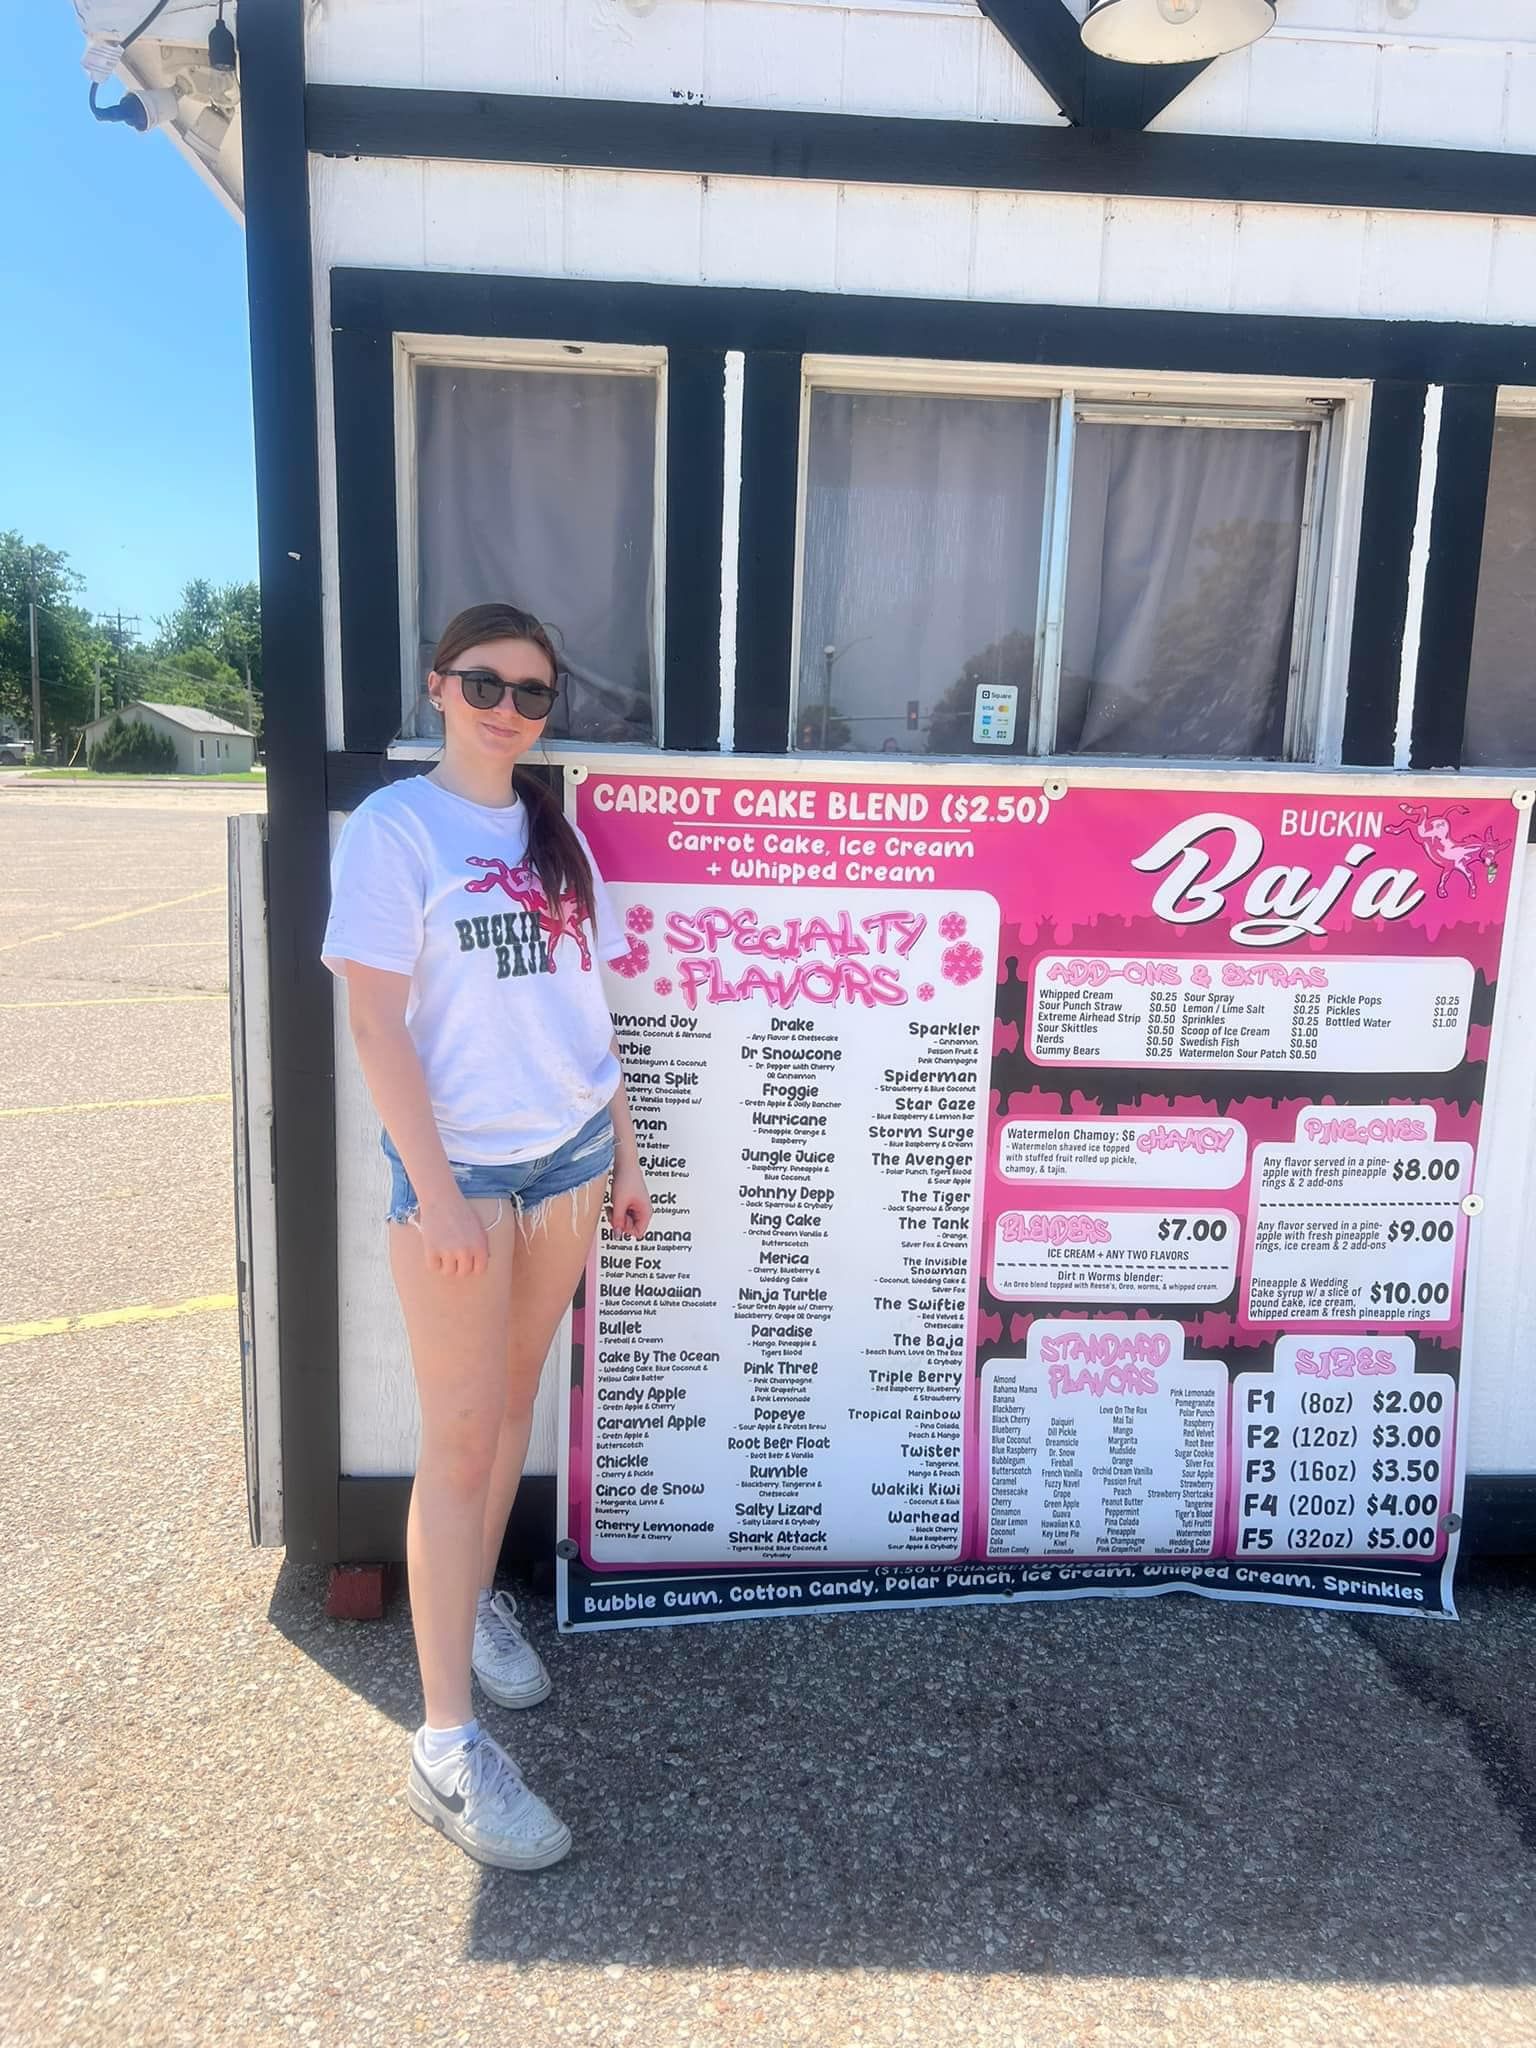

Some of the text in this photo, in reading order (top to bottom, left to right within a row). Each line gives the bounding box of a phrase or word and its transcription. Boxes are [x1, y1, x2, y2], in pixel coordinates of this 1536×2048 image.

[593, 783, 1049, 824] CARROT CAKE BLEND ($2.50)
[1280, 810, 1384, 839] BUCKIN
[667, 830, 974, 858] Carrot Cake, Ice Cream
[706, 858, 935, 882] + Whipped Cream
[1131, 812, 1425, 946] Baja
[455, 911, 542, 952] BUCKIN
[496, 941, 550, 979] BAJA
[1040, 990, 1177, 1001] Whipped Cream $0.25
[1184, 993, 1320, 1005] Sour Spray $0.25
[1328, 995, 1459, 1006] Pickle Pops $0.25
[1039, 1001, 1176, 1012] Sour Punch Straw $0.50
[1183, 1004, 1319, 1015] Lemon / Lime Salt $0.25
[1326, 1006, 1458, 1016] Pickles $1.00
[610, 1013, 698, 1031] lmond Joy
[771, 1018, 814, 1031] Drake
[1038, 1012, 1175, 1024] Extreme Airhead Strip $0.50
[1182, 1015, 1318, 1026] Sprinkles $0.25
[1326, 1017, 1456, 1027] Bottled Water $1.00
[909, 1022, 980, 1038] Sparkler
[1037, 1024, 1174, 1035] Sour Skittles $0.50
[1181, 1026, 1318, 1038] Scoop of Ice Cream $1.00
[1037, 1035, 1173, 1046] Nerds $0.50
[1180, 1037, 1317, 1048] Swedish Fish $0.50
[741, 1046, 842, 1061] Dr Snowcone
[1036, 1046, 1172, 1057] Gummy Bears $0.25
[1179, 1048, 1316, 1059] Watermelon Sour Patch $0.50
[884, 1069, 977, 1085] Spiderman
[762, 1083, 819, 1101] Froggie
[895, 1098, 976, 1110] Star Gaze
[752, 1111, 827, 1127] Hurricane
[869, 1126, 974, 1141] Storm Surge
[1007, 1128, 1135, 1142] Watermelon Chamoy: $6
[1264, 1157, 1281, 1168] Any
[1284, 1157, 1311, 1167] flavor
[1314, 1158, 1345, 1166] served
[1348, 1158, 1356, 1166] in
[1367, 1158, 1390, 1168] pine-
[1392, 1158, 1460, 1181] $8.00
[1158, 1219, 1227, 1241] $7.00
[1387, 1220, 1454, 1242] $9.00
[1048, 1248, 1062, 1258] ICE
[1064, 1249, 1095, 1258] CREAM
[1106, 1250, 1124, 1259] ANY
[1128, 1251, 1147, 1259] TWO
[1150, 1251, 1189, 1260] FLAVORS
[600, 1255, 661, 1269] Blue Fox
[1058, 1272, 1163, 1282] Dirt n Worms blender:
[1370, 1281, 1449, 1304] $10.00
[599, 1321, 642, 1335] Bullet
[994, 1375, 1016, 1384] Almond
[1248, 1389, 1443, 1414] F1 (8oz) $2.00
[754, 1407, 806, 1423] Popeye
[1248, 1425, 1441, 1448] F2 (12oz) $3.00
[901, 1444, 960, 1458] Twister
[597, 1455, 648, 1467] Chickle
[1246, 1459, 1439, 1483] F3 (16oz) $3.50
[872, 1483, 960, 1496] Wakiki Kiwi
[1244, 1493, 1437, 1517] F4 (20oz) $4.00
[888, 1511, 959, 1523] Warhead
[1242, 1528, 1435, 1549] F5 (32oz) $5.00
[584, 1592, 656, 1613] Bubble
[664, 1590, 722, 1607] Gum,
[730, 1584, 802, 1602] Cotton
[809, 1579, 878, 1598] Candy,
[885, 1575, 937, 1591] Polar
[947, 1570, 1015, 1587] Punch,
[1023, 1569, 1051, 1582] Ice
[1059, 1566, 1136, 1580] Cream,
[1236, 1568, 1316, 1589] Cream,
[1323, 1576, 1424, 1601] Sprinkles
